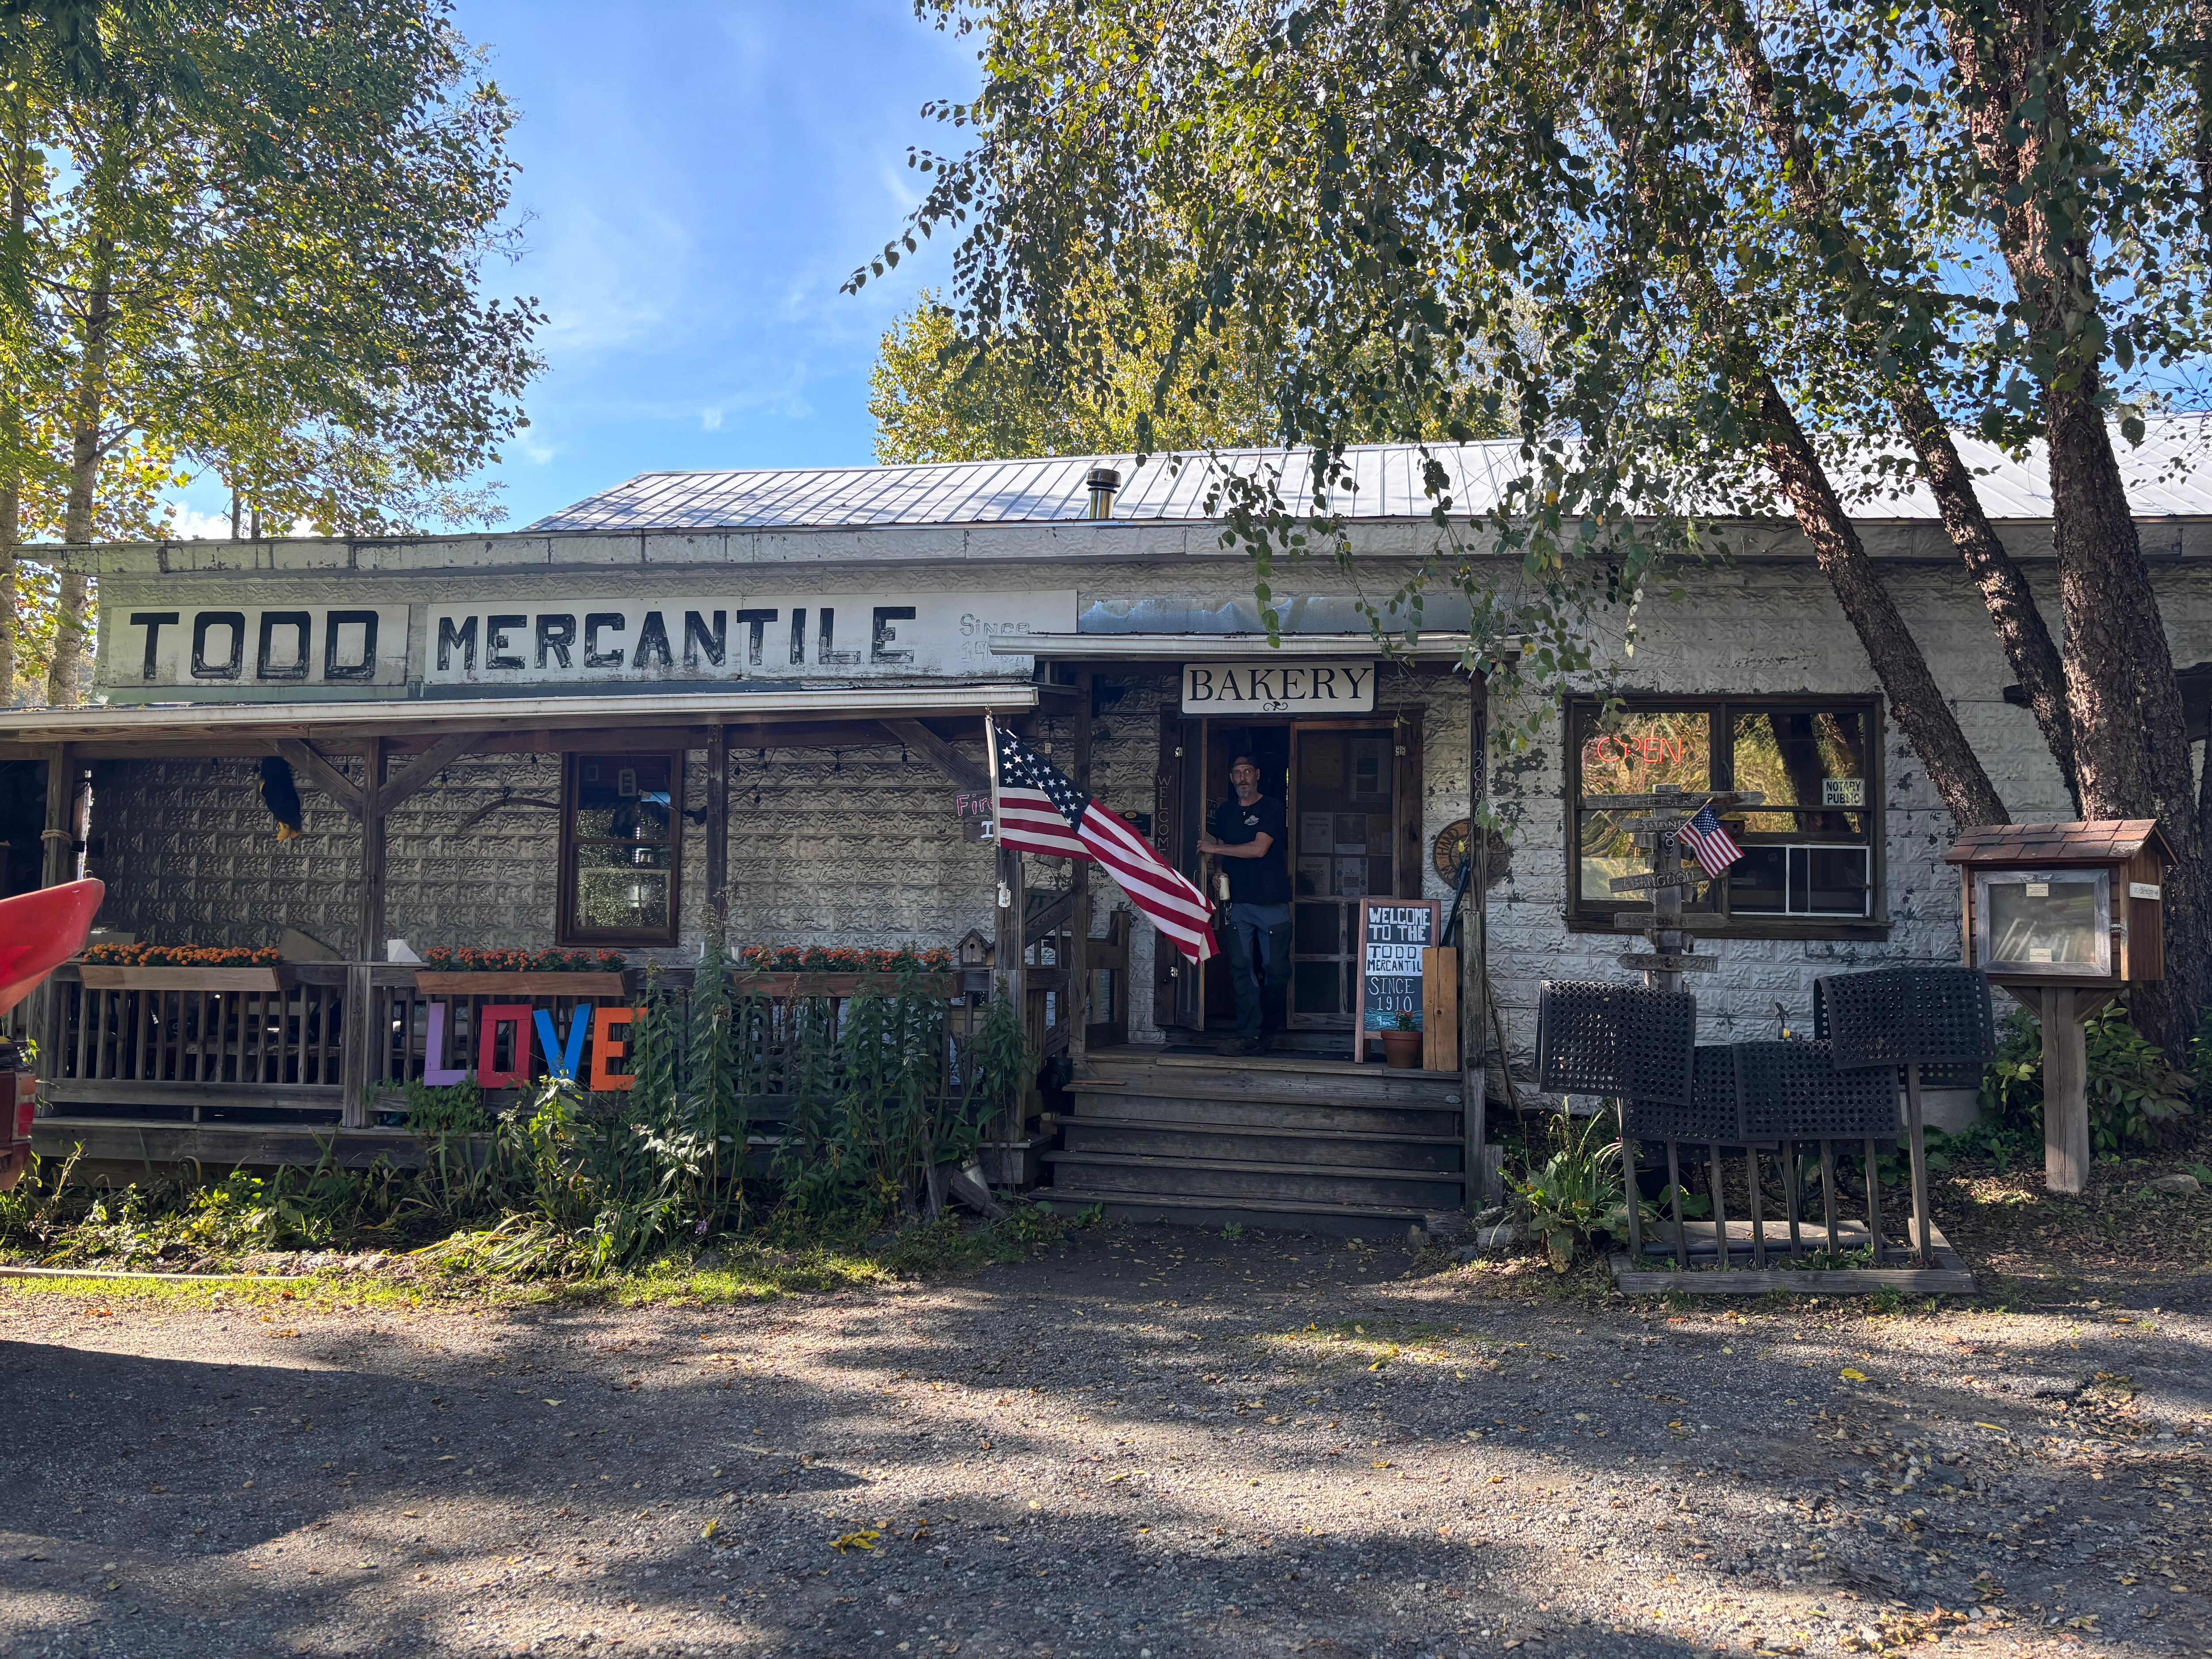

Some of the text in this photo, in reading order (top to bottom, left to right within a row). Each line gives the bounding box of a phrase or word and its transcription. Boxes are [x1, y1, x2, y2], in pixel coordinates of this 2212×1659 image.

[130, 611, 379, 680] TODD
[437, 606, 917, 671] MERCANTILE
[1187, 668, 1372, 701] BAKERY
[1597, 737, 1682, 763] OPEN
[1474, 750, 1483, 820] 389
[1826, 781, 1861, 791] NOTARY
[1828, 793, 1859, 804] PUBLIC
[1622, 870, 1694, 890] ABINGDON
[1369, 907, 1430, 926] WELCOME
[1623, 915, 1673, 926] BOSTON
[1369, 924, 1426, 941] TO THE
[1369, 945, 1416, 959] TODD
[1367, 959, 1422, 972] MERCANTIL
[1625, 956, 1685, 969] CARACAS
[1368, 976, 1415, 995] SINCE
[1377, 996, 1413, 1012] 1910
[423, 1003, 648, 1091] LOVE
